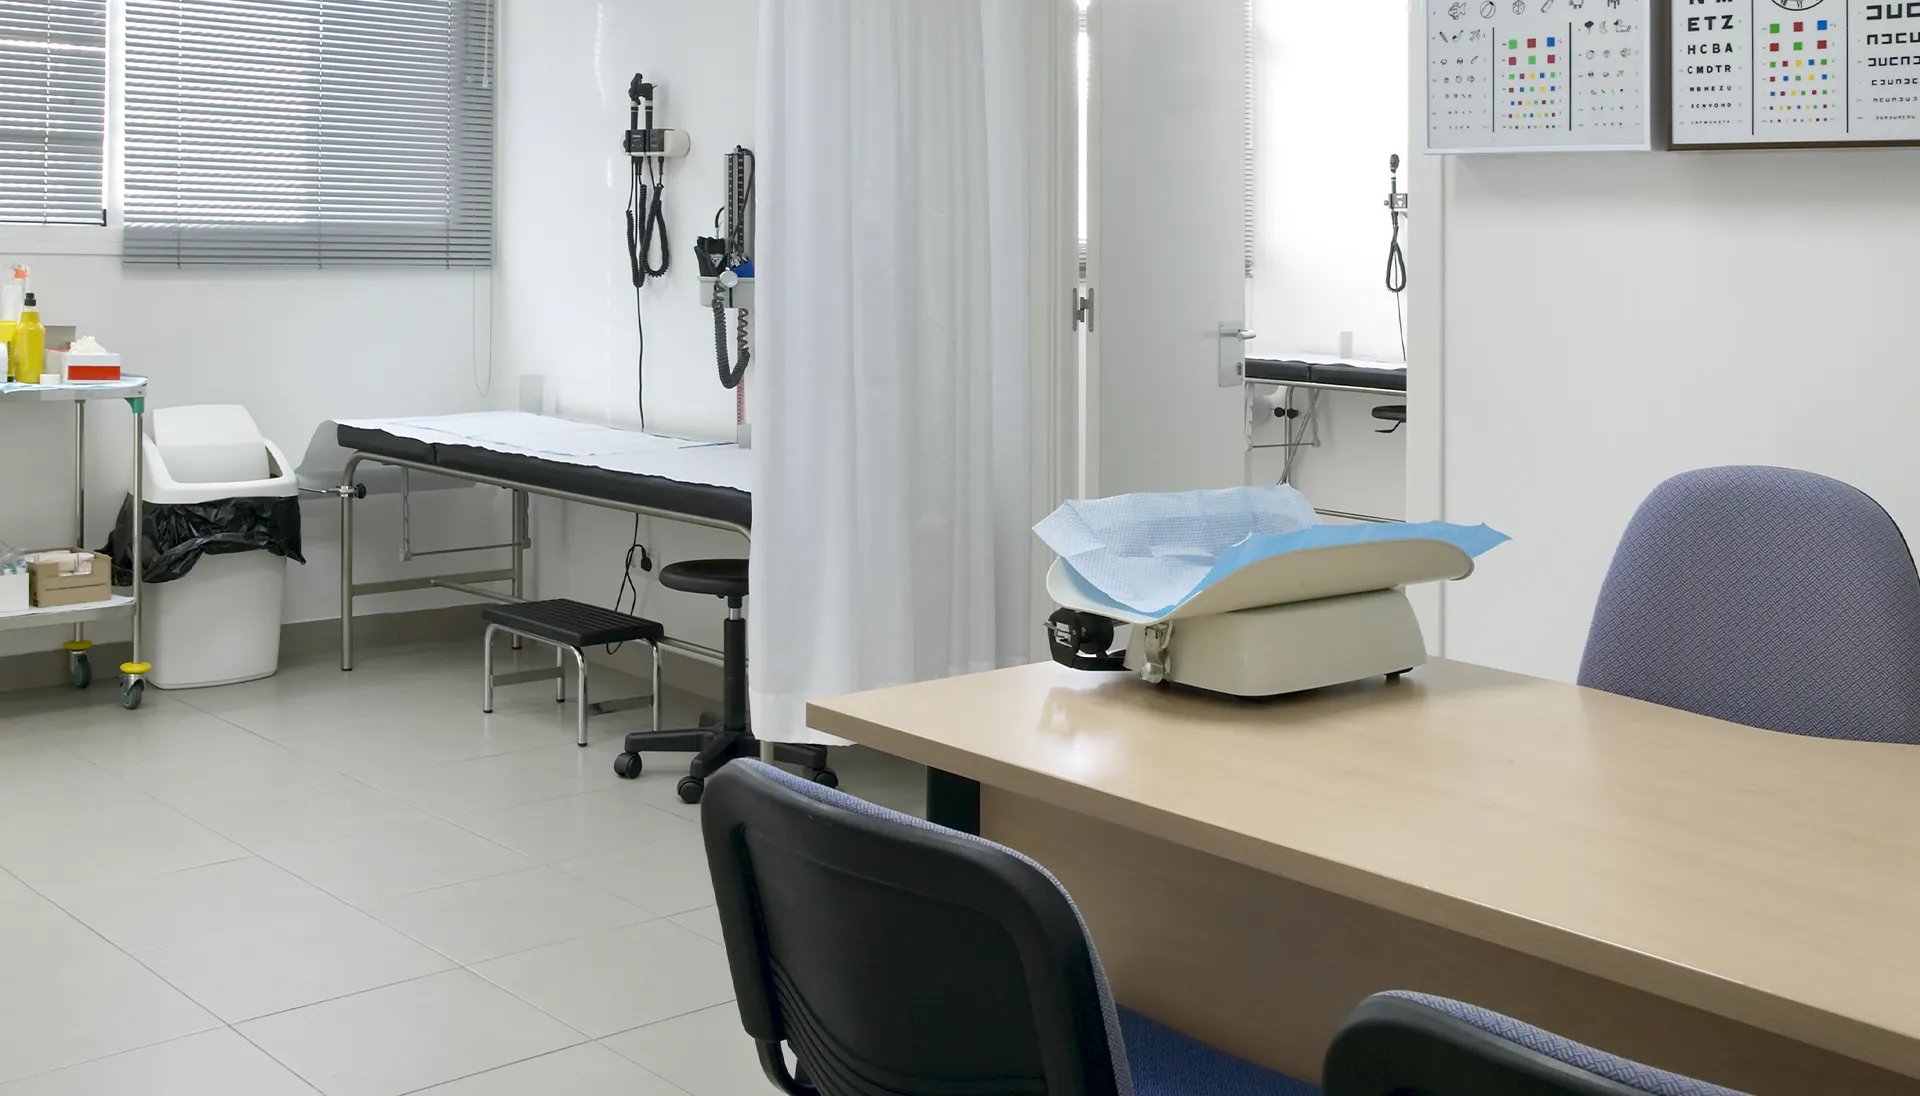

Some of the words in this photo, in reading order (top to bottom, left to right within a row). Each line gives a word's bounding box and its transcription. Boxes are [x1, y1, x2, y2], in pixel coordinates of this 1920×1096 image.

[1688, 14, 1734, 32] ETZ
[1687, 42, 1733, 55] HCBA
[1687, 64, 1731, 75] CMDTR
